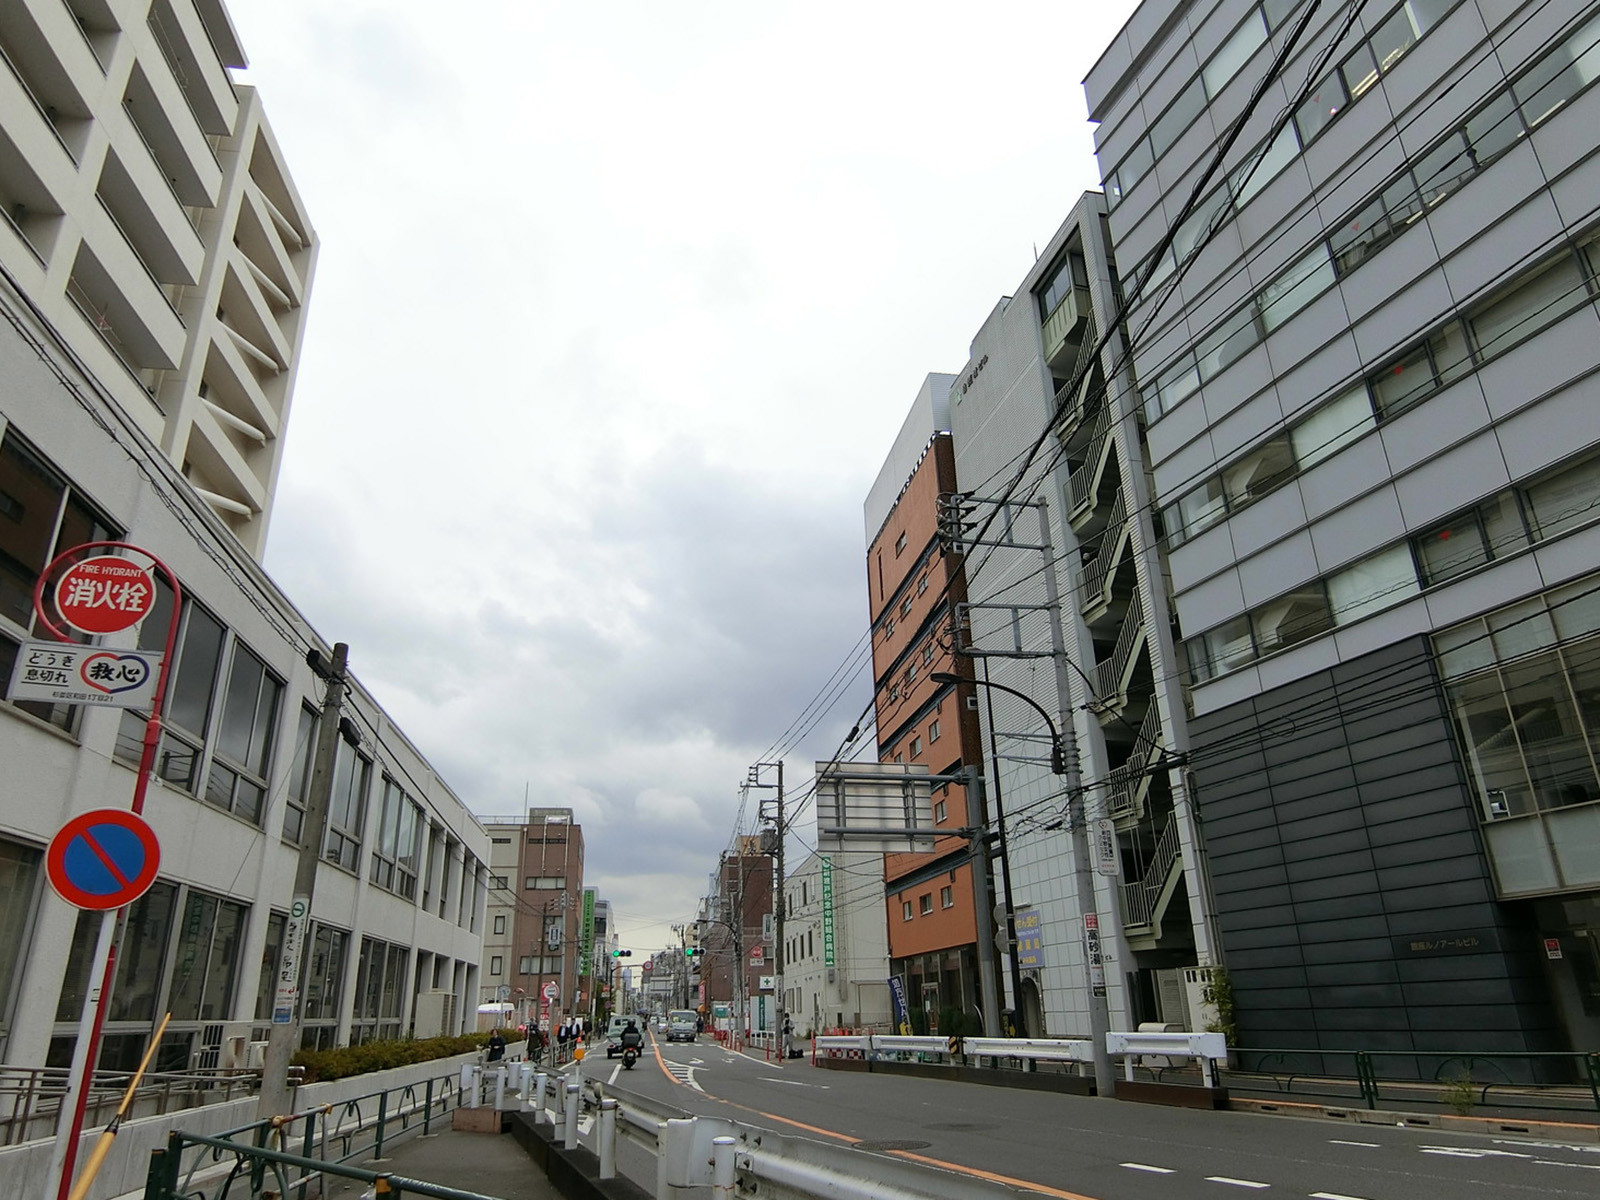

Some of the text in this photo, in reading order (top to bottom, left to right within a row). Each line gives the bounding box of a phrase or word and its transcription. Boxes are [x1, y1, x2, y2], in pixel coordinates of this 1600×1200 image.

[79, 564, 143, 578] FIRE HYDRANT
[65, 577, 148, 612] 消火栓
[29, 652, 74, 668] どうき
[24, 669, 69, 684] 息切れ
[90, 662, 140, 683] 救心
[1087, 928, 1102, 965] 高砂湯
